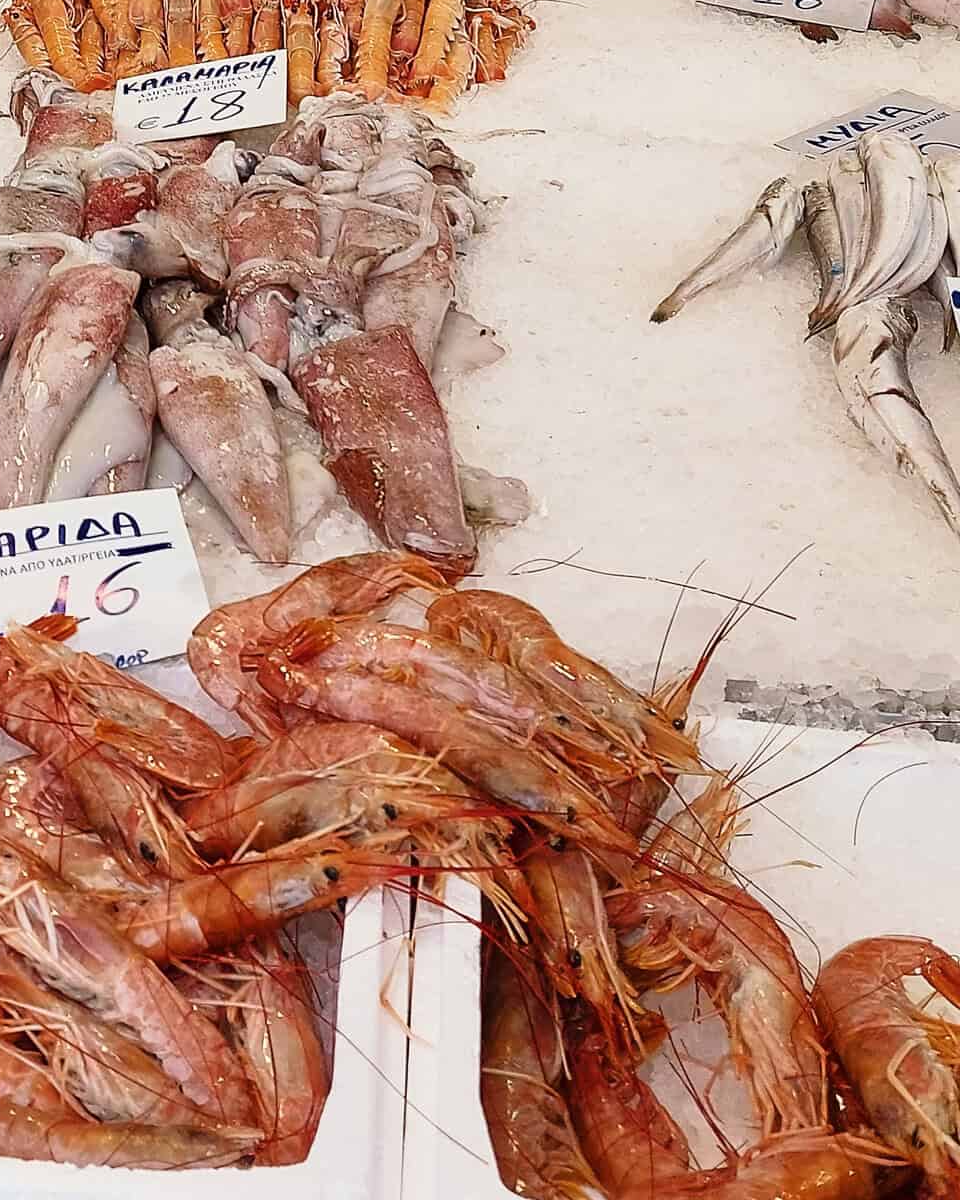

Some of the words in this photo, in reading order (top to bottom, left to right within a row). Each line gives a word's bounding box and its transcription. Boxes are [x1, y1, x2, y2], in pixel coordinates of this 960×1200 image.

[123, 55, 276, 96] ΚΑΛΑΜΑΡΙΑ
[162, 90, 247, 129] 18
[19, 560, 45, 574] ΑΠΟ
[50, 561, 142, 619] 16
